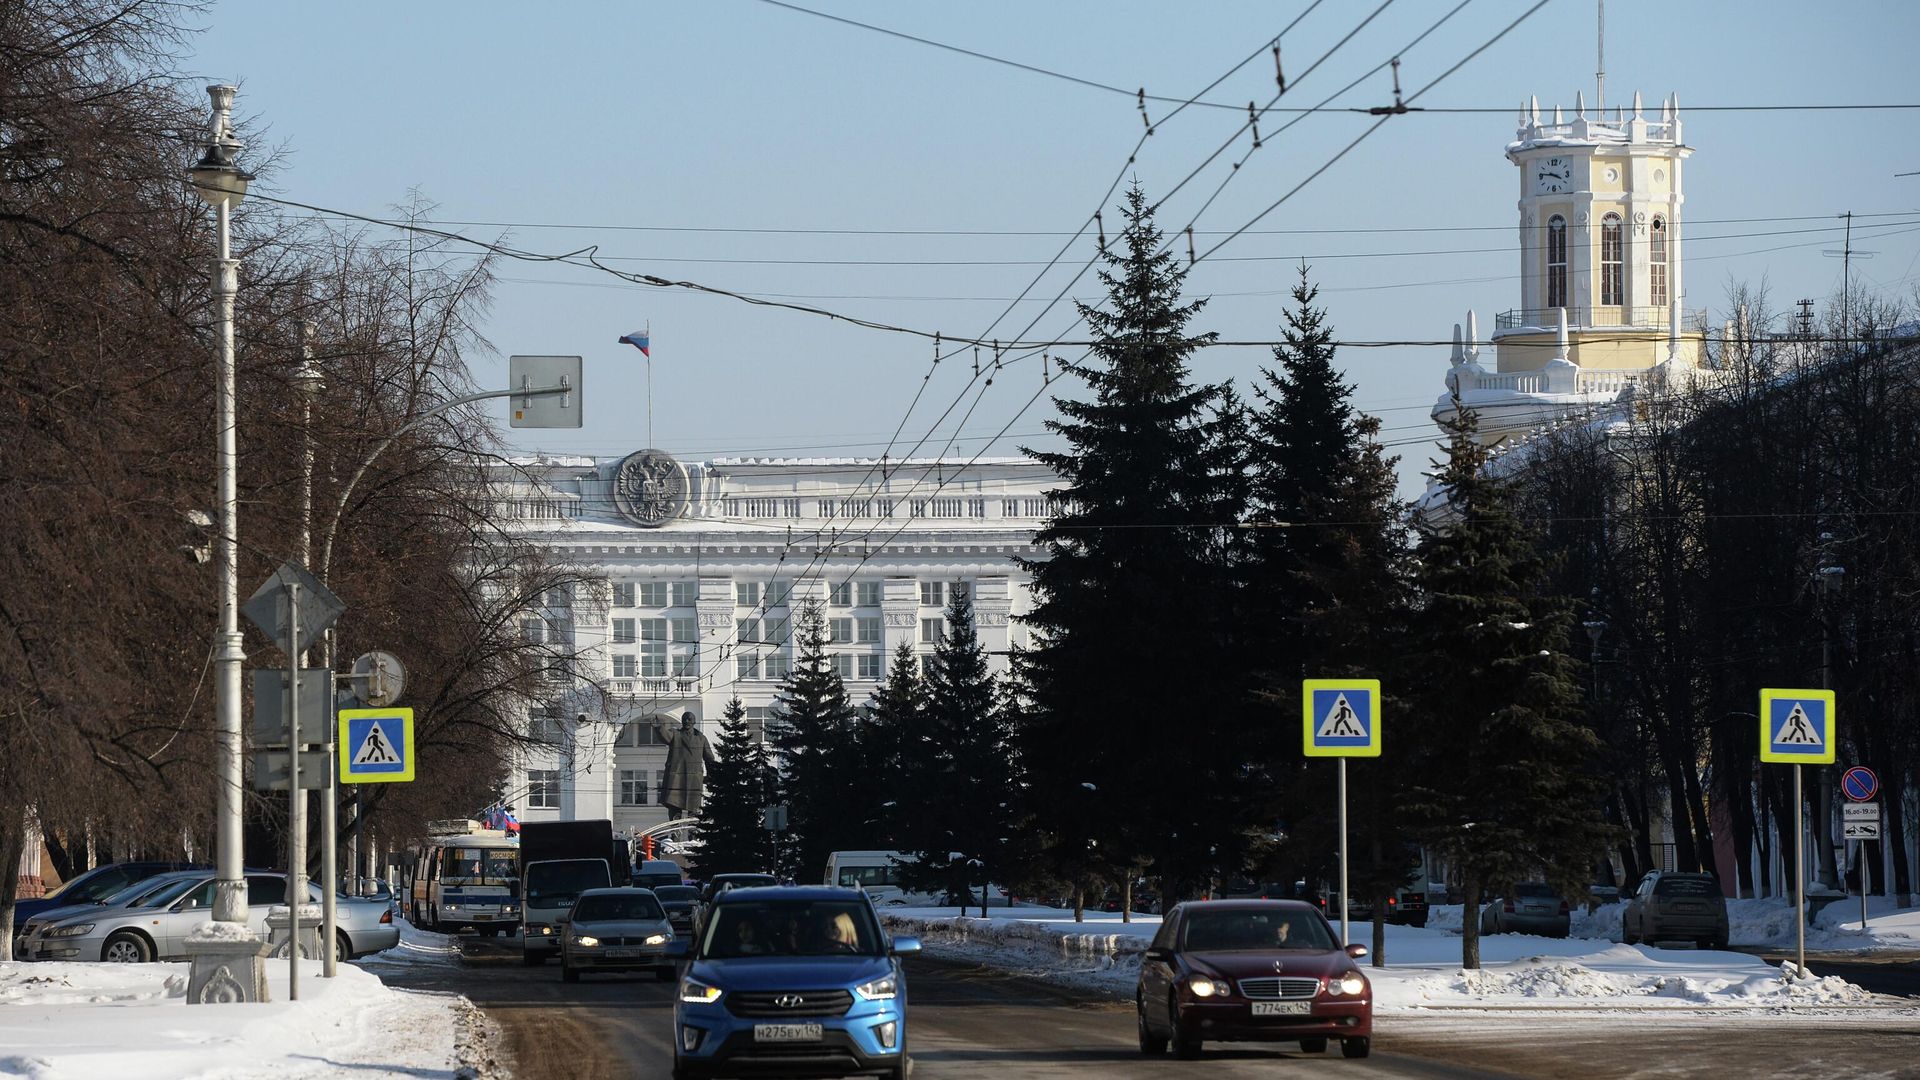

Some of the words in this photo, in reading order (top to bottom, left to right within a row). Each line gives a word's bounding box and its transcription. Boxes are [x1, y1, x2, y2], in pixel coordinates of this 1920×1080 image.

[1565, 170, 1570, 178] 3
[490, 851, 515, 859] КОСМОС
[805, 1025, 820, 1036] 142
